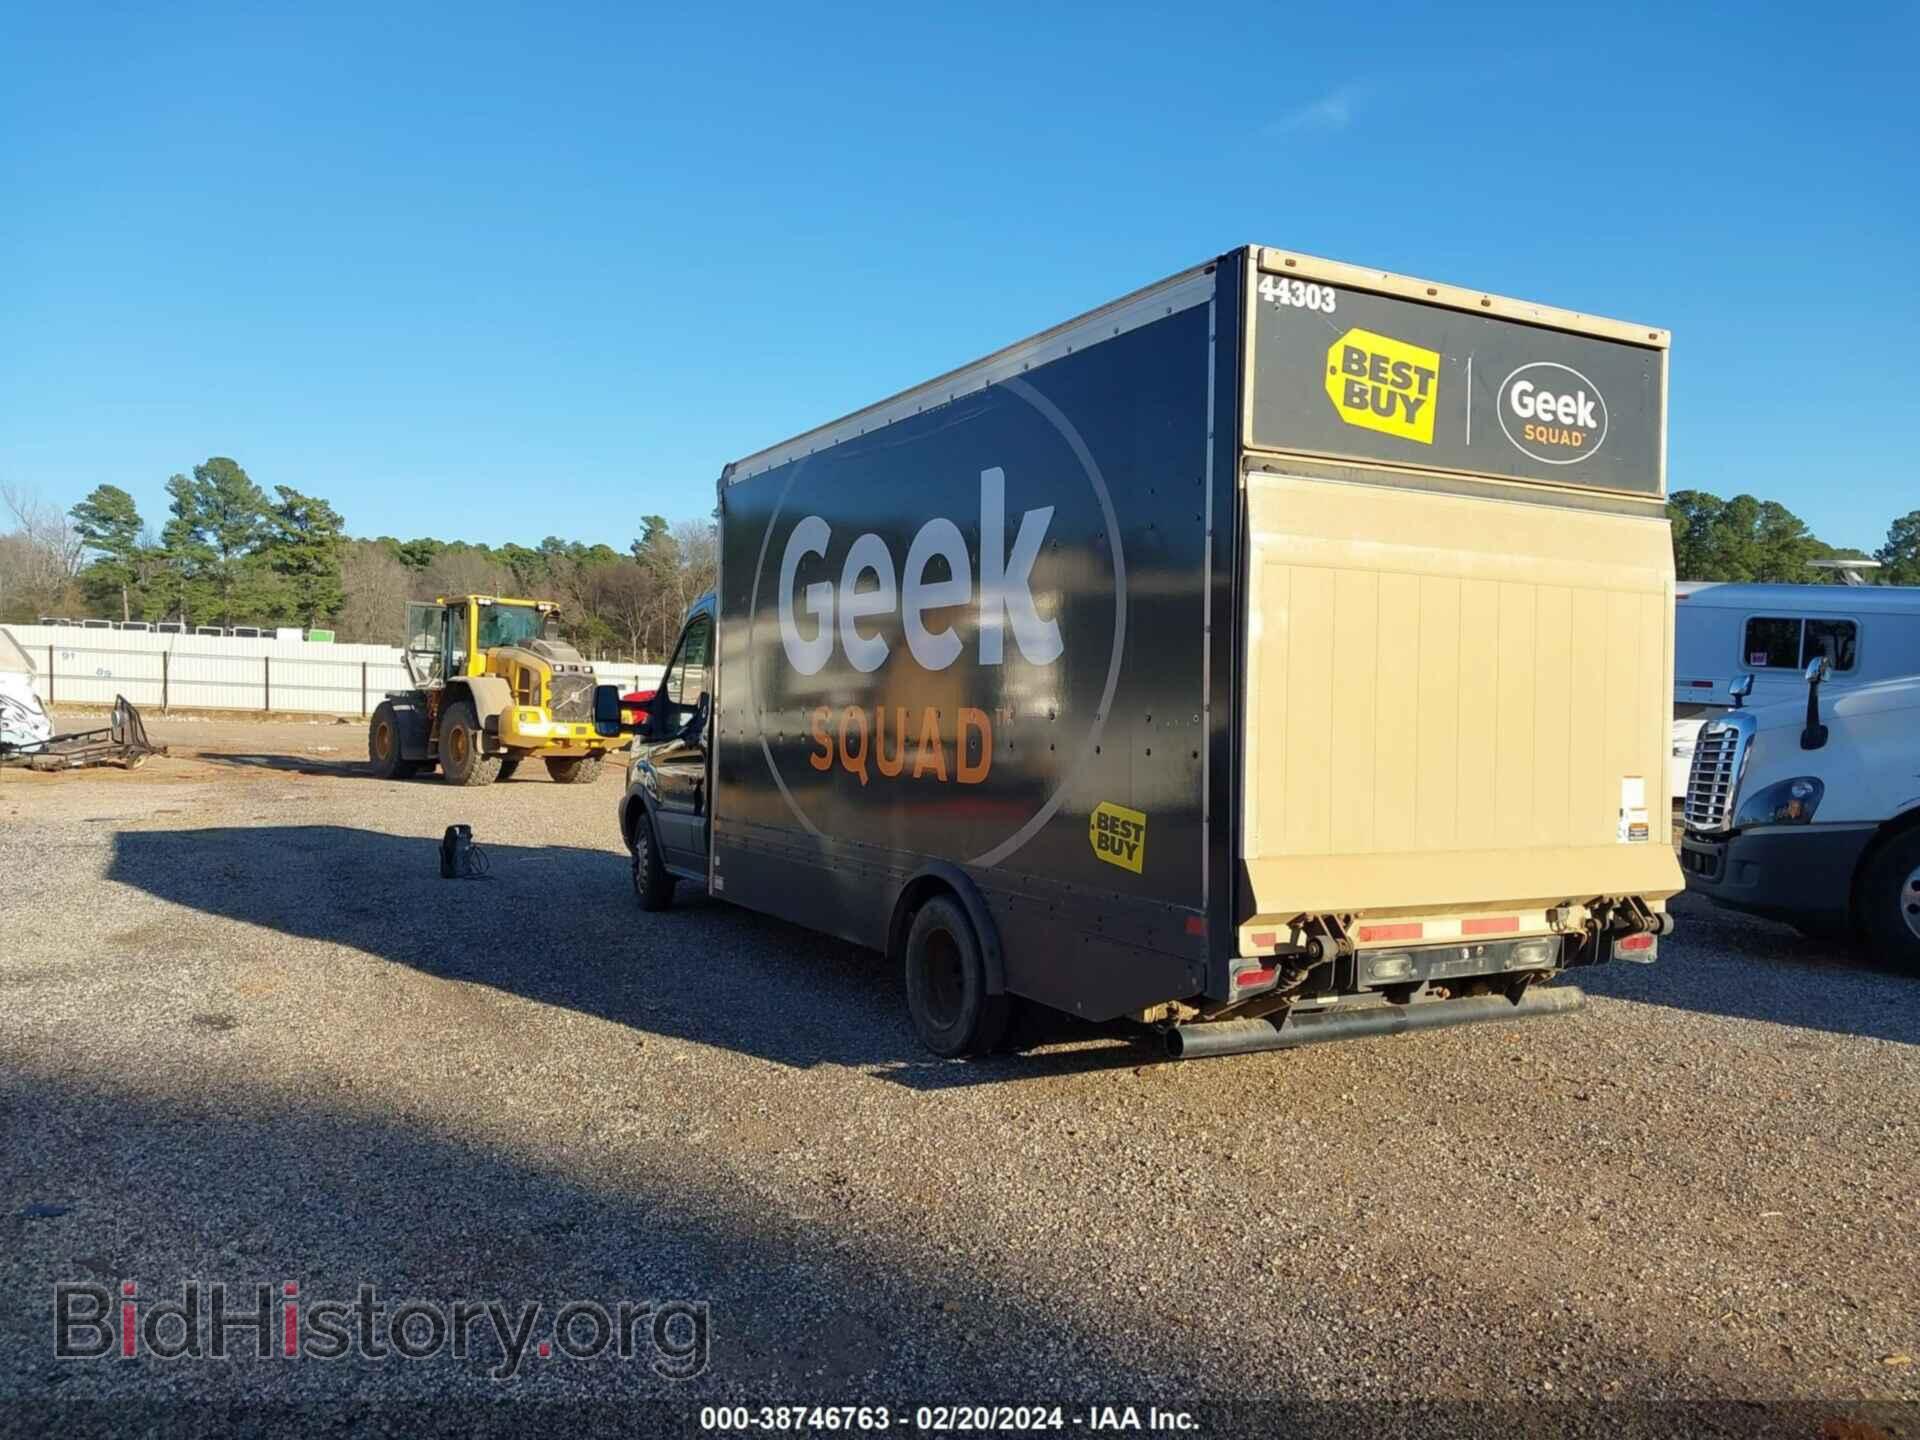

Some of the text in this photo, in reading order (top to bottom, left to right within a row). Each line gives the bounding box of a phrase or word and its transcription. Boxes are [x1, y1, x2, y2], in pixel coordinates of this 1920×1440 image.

[1259, 275, 1336, 313] 44303
[1341, 345, 1436, 397] BEST
[1342, 377, 1427, 425] BUY
[1511, 380, 1598, 429] Geek
[1524, 424, 1582, 447] SQUAD
[778, 467, 1064, 676] Geek
[810, 705, 992, 786] SQUAD
[1097, 812, 1144, 843] BEST
[1097, 831, 1139, 861] BUY
